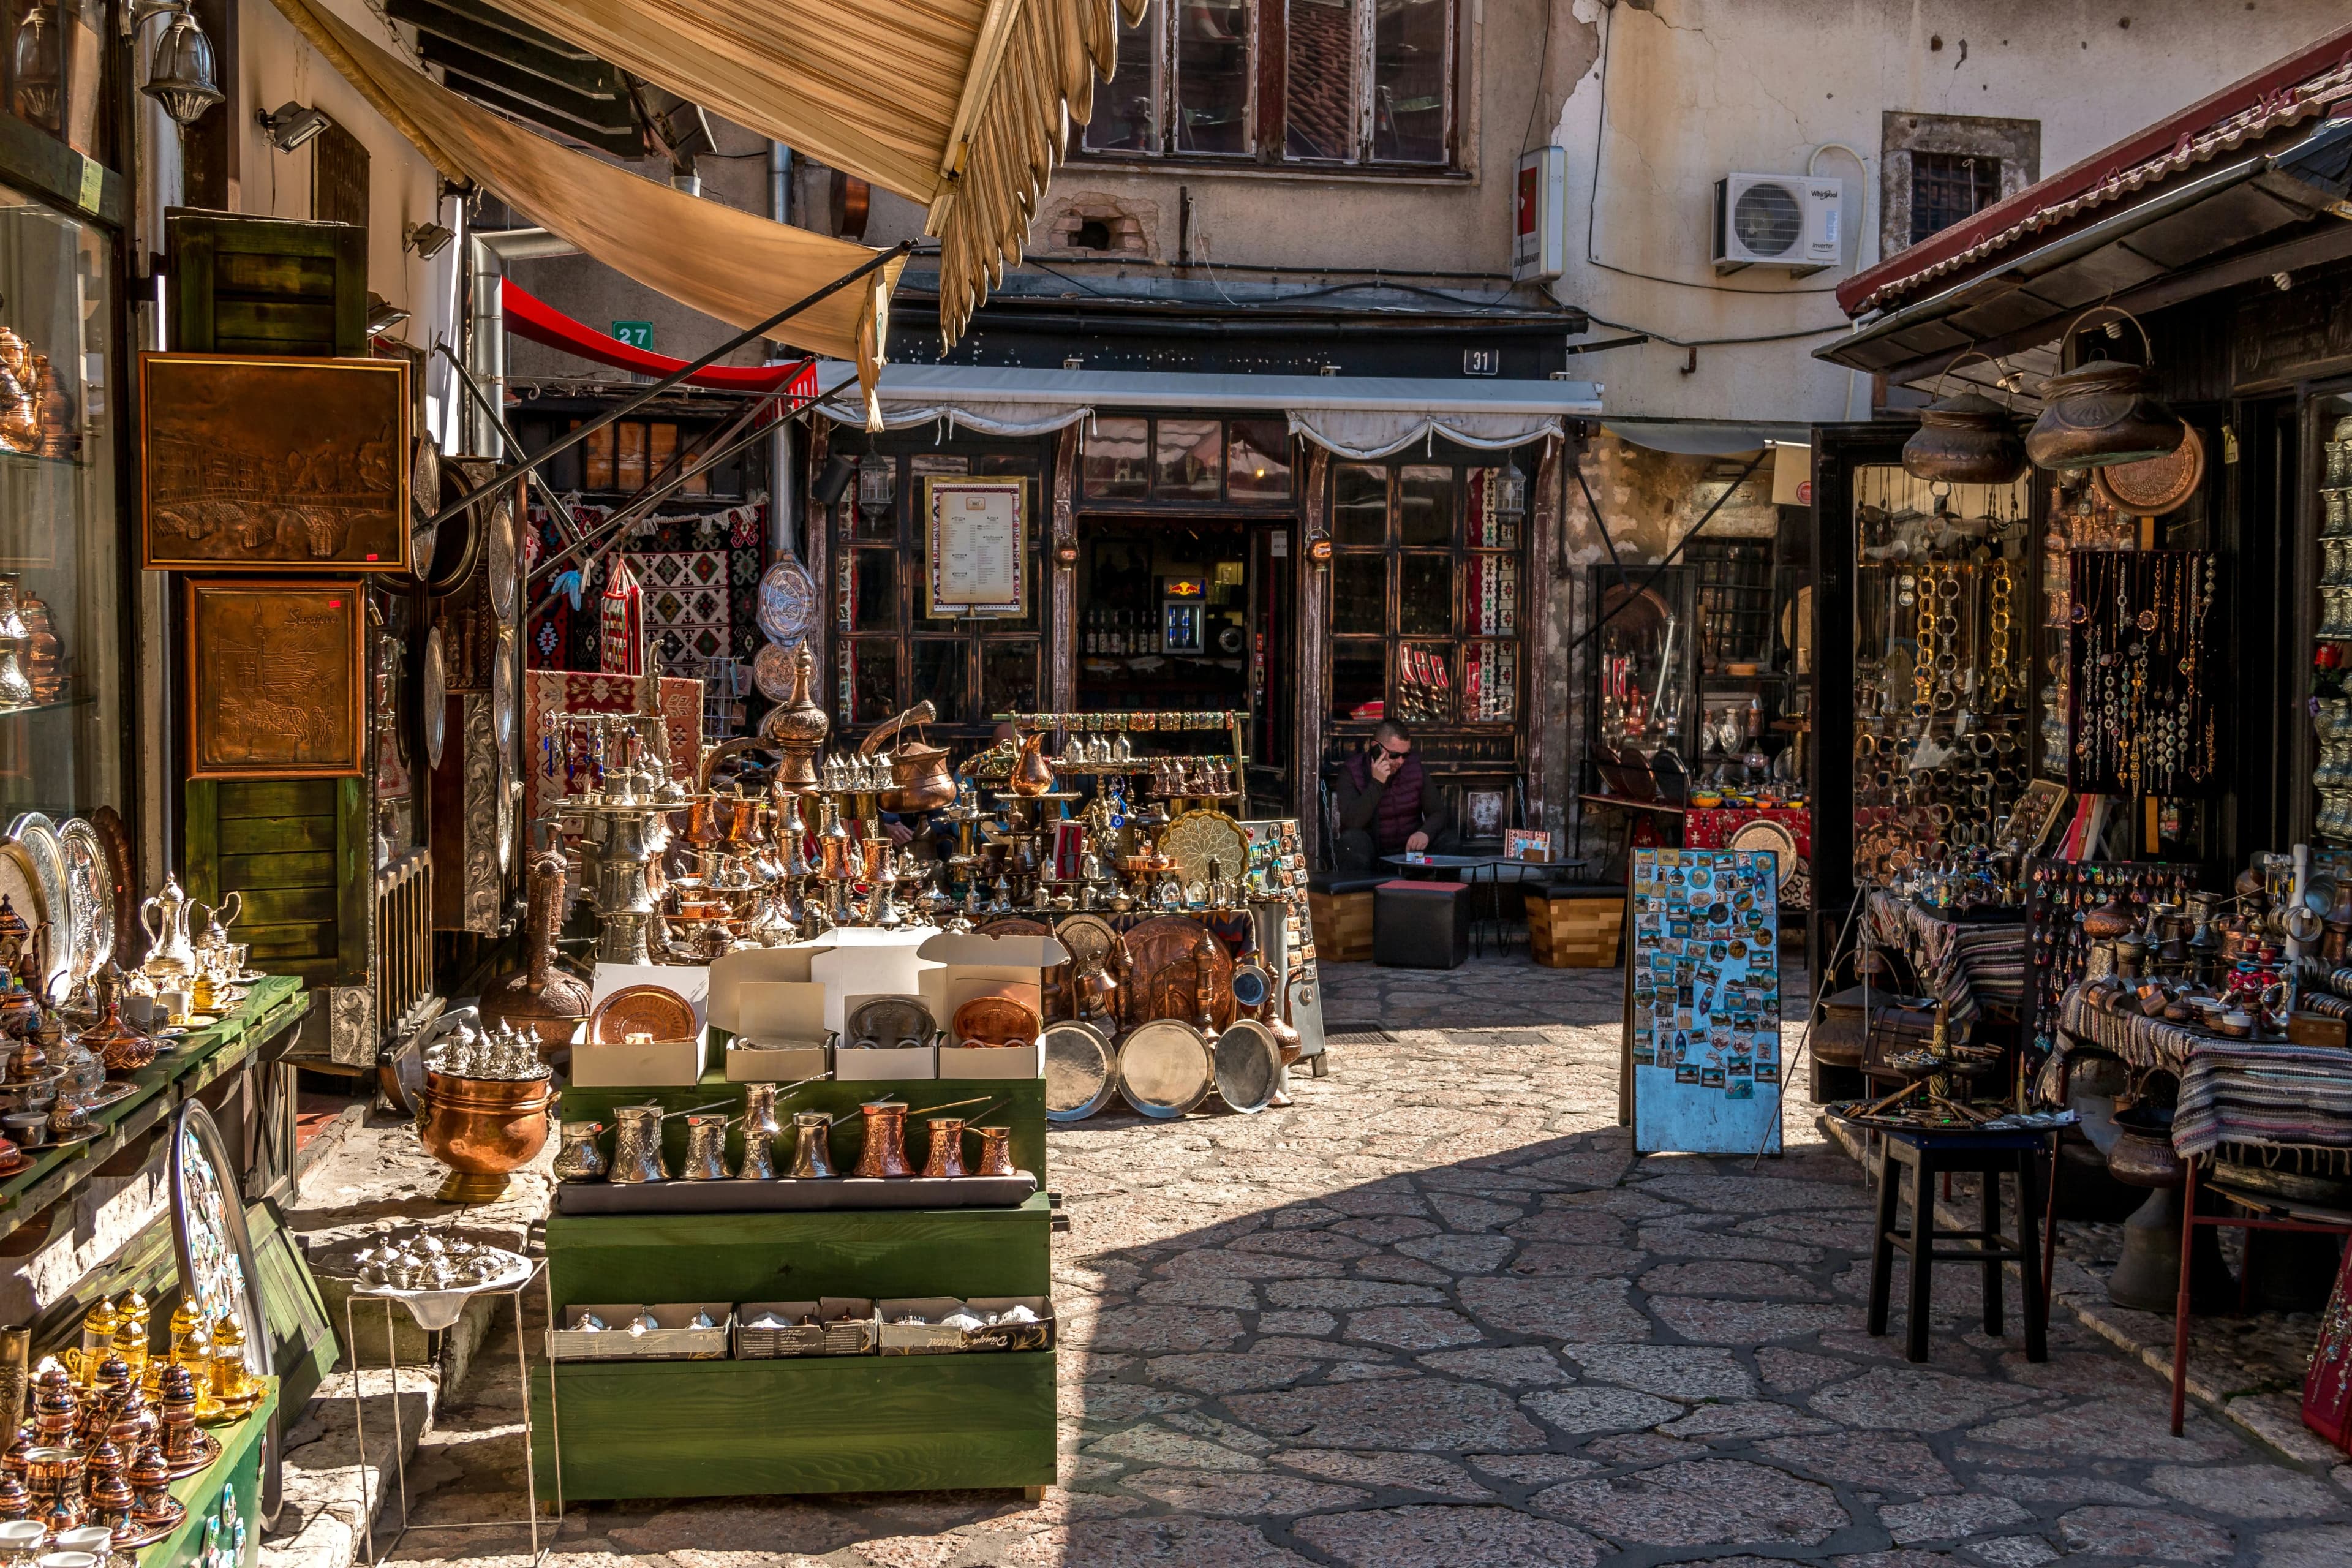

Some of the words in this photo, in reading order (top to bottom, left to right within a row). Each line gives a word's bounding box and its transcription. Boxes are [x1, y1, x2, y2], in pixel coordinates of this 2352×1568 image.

[1811, 190, 1838, 200] Whirlpool
[619, 328, 647, 344] 27
[1473, 351, 1488, 371] 31
[284, 607, 337, 628] Sarajevo
[971, 1334, 1008, 1347] Dünya
